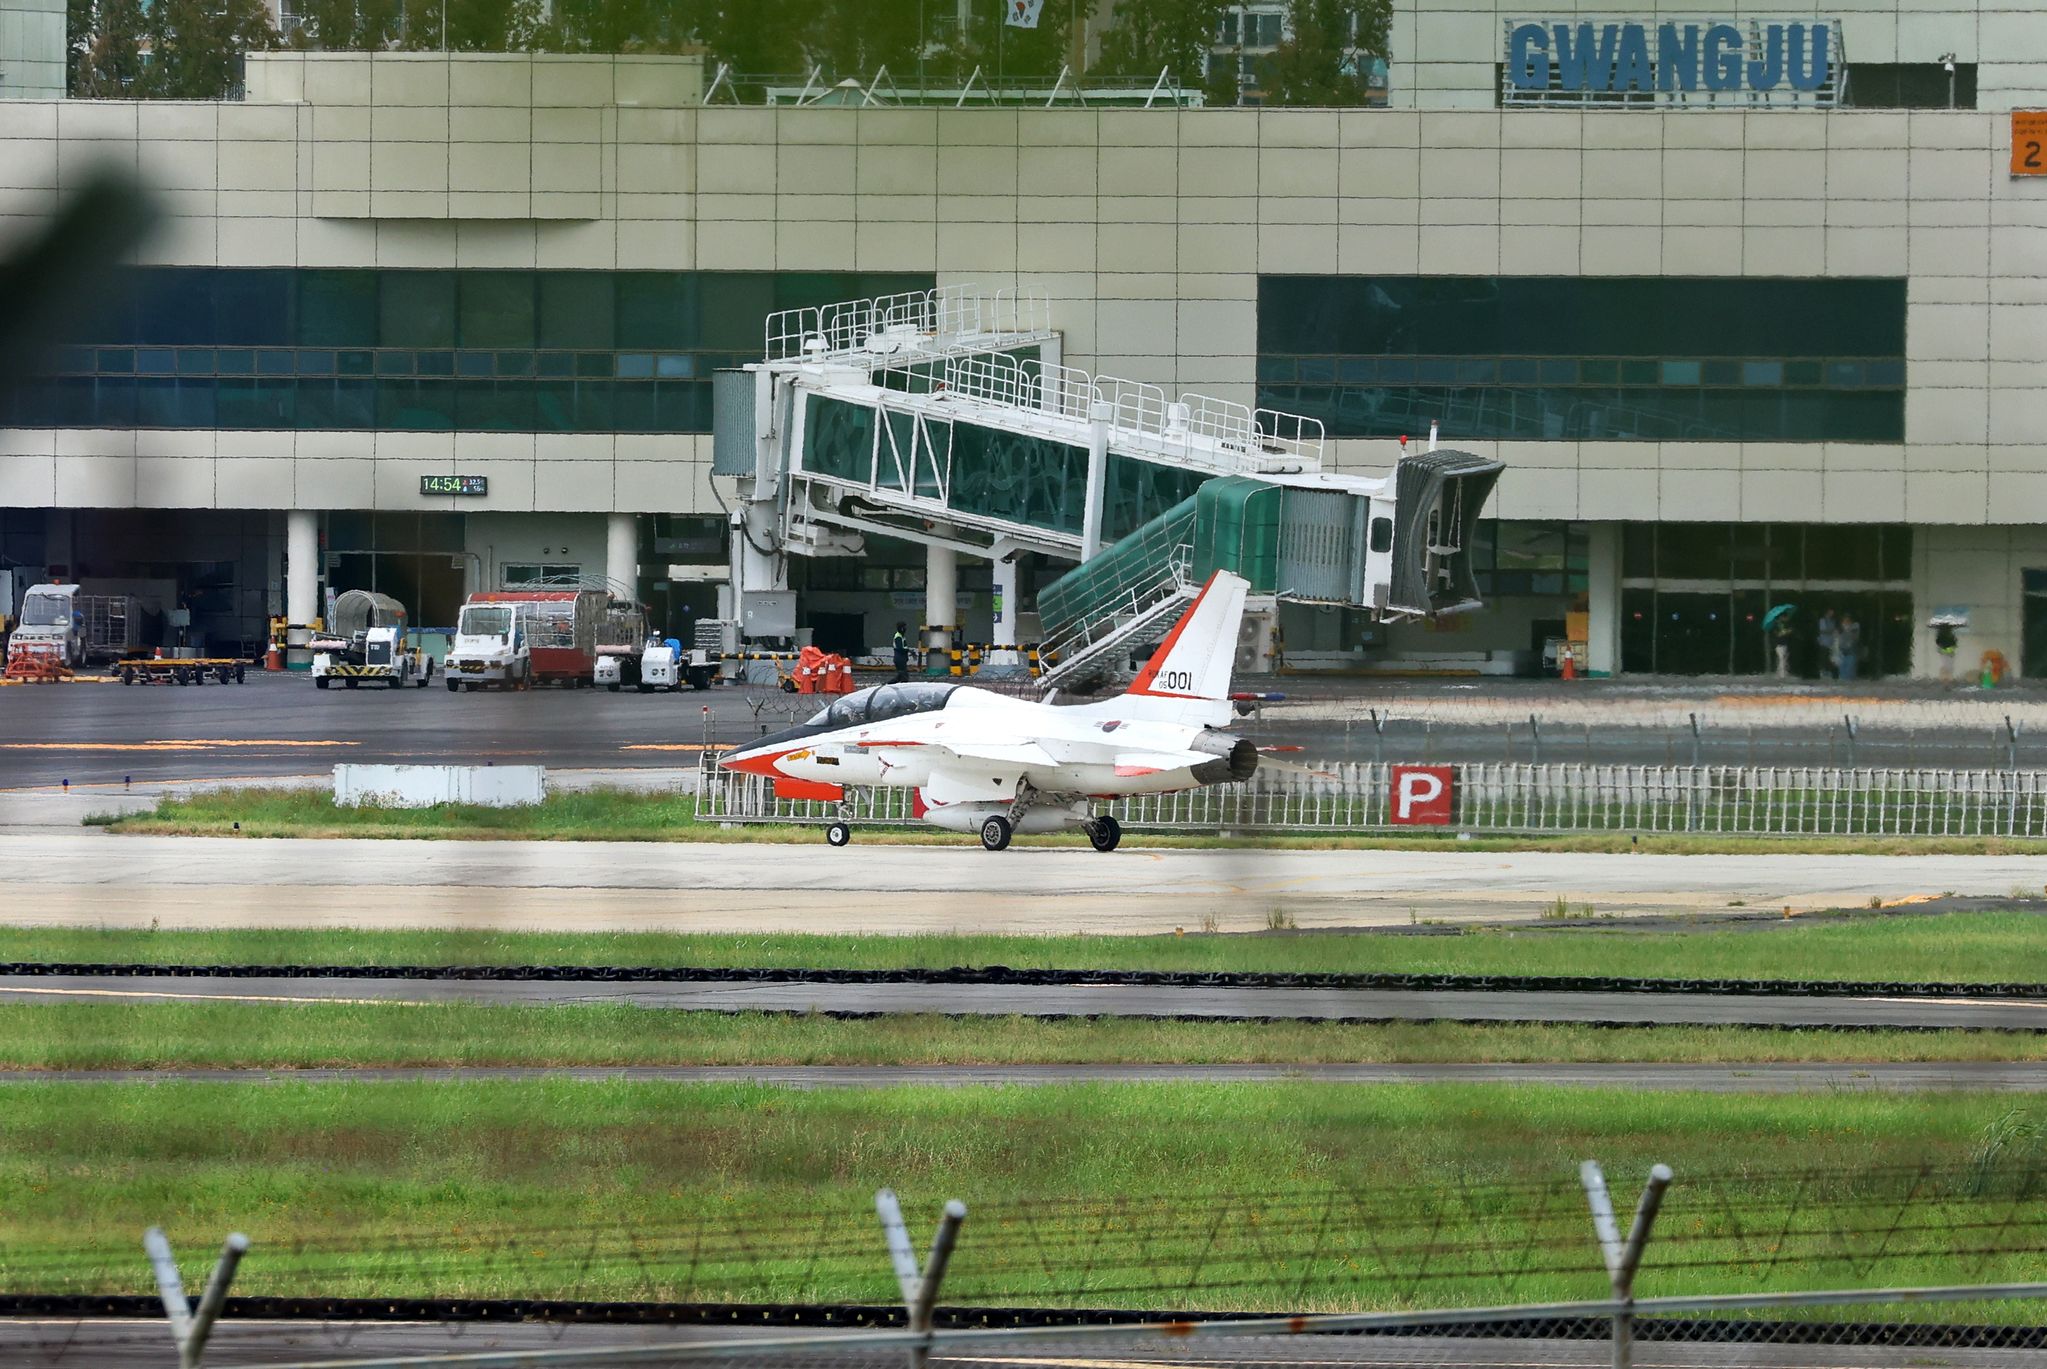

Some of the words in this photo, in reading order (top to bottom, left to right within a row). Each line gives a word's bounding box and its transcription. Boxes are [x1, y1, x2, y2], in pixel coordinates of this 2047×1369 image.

[1510, 23, 1830, 92] GWANGJU
[2024, 141, 2042, 168] 2
[423, 478, 461, 491] 14:54
[1167, 671, 1192, 691] 001
[1398, 772, 1443, 818] P
